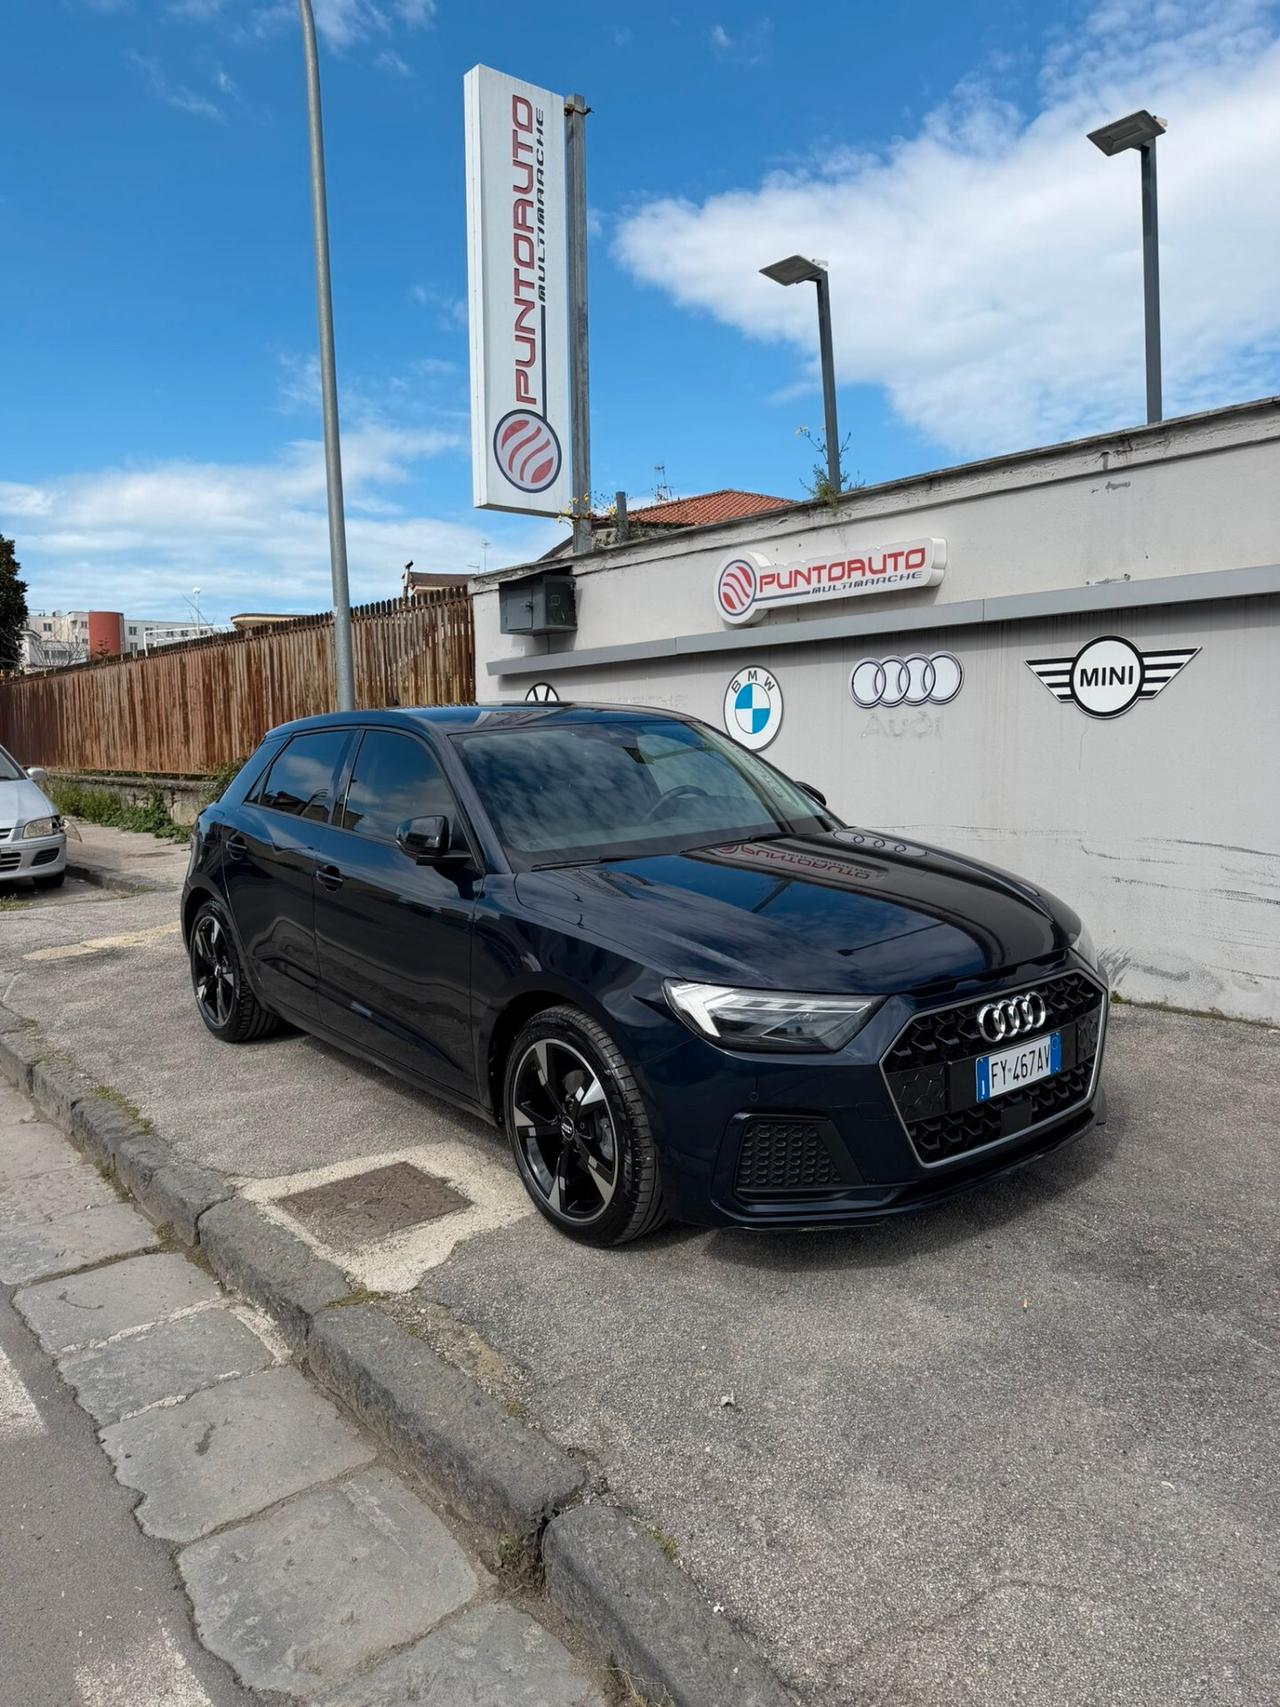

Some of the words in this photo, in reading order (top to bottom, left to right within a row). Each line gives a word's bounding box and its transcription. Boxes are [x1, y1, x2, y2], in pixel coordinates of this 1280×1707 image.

[537, 107, 546, 303] MULTIMARCHE
[513, 95, 537, 405] PUNTOAUTO
[759, 547, 926, 593] PUNTOAUTO
[811, 570, 923, 595] MULTIMARCHE
[731, 669, 776, 695] BMW
[1079, 665, 1134, 688] MINI
